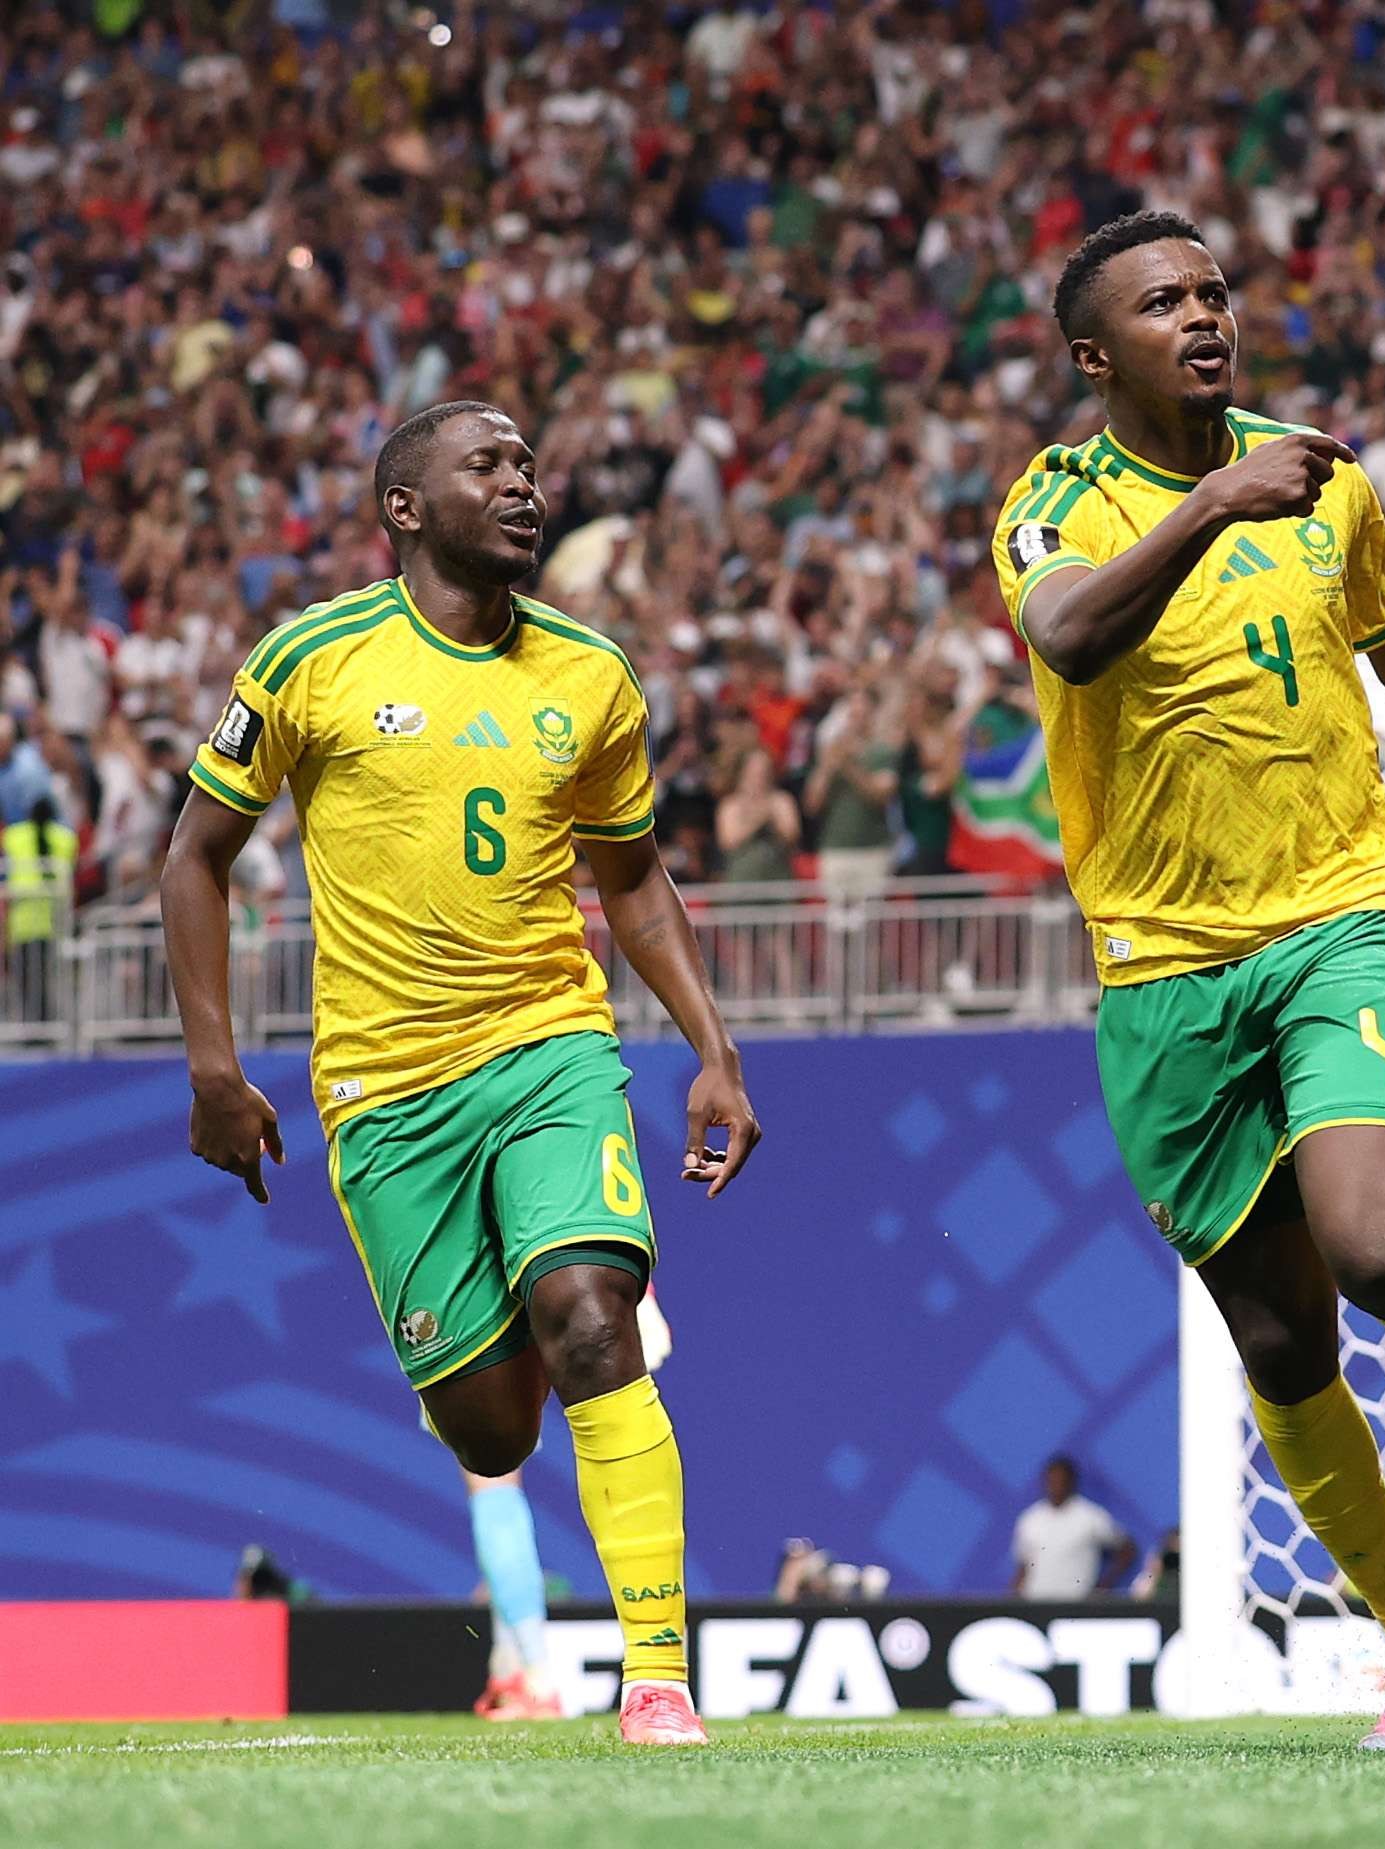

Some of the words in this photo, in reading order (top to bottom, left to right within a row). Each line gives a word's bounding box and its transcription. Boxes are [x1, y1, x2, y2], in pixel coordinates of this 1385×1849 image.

[1242, 614, 1300, 708] 4
[464, 786, 506, 876] 6
[601, 1132, 643, 1217] 6
[622, 1581, 683, 1604] SAFA
[546, 1617, 898, 1718] FFA
